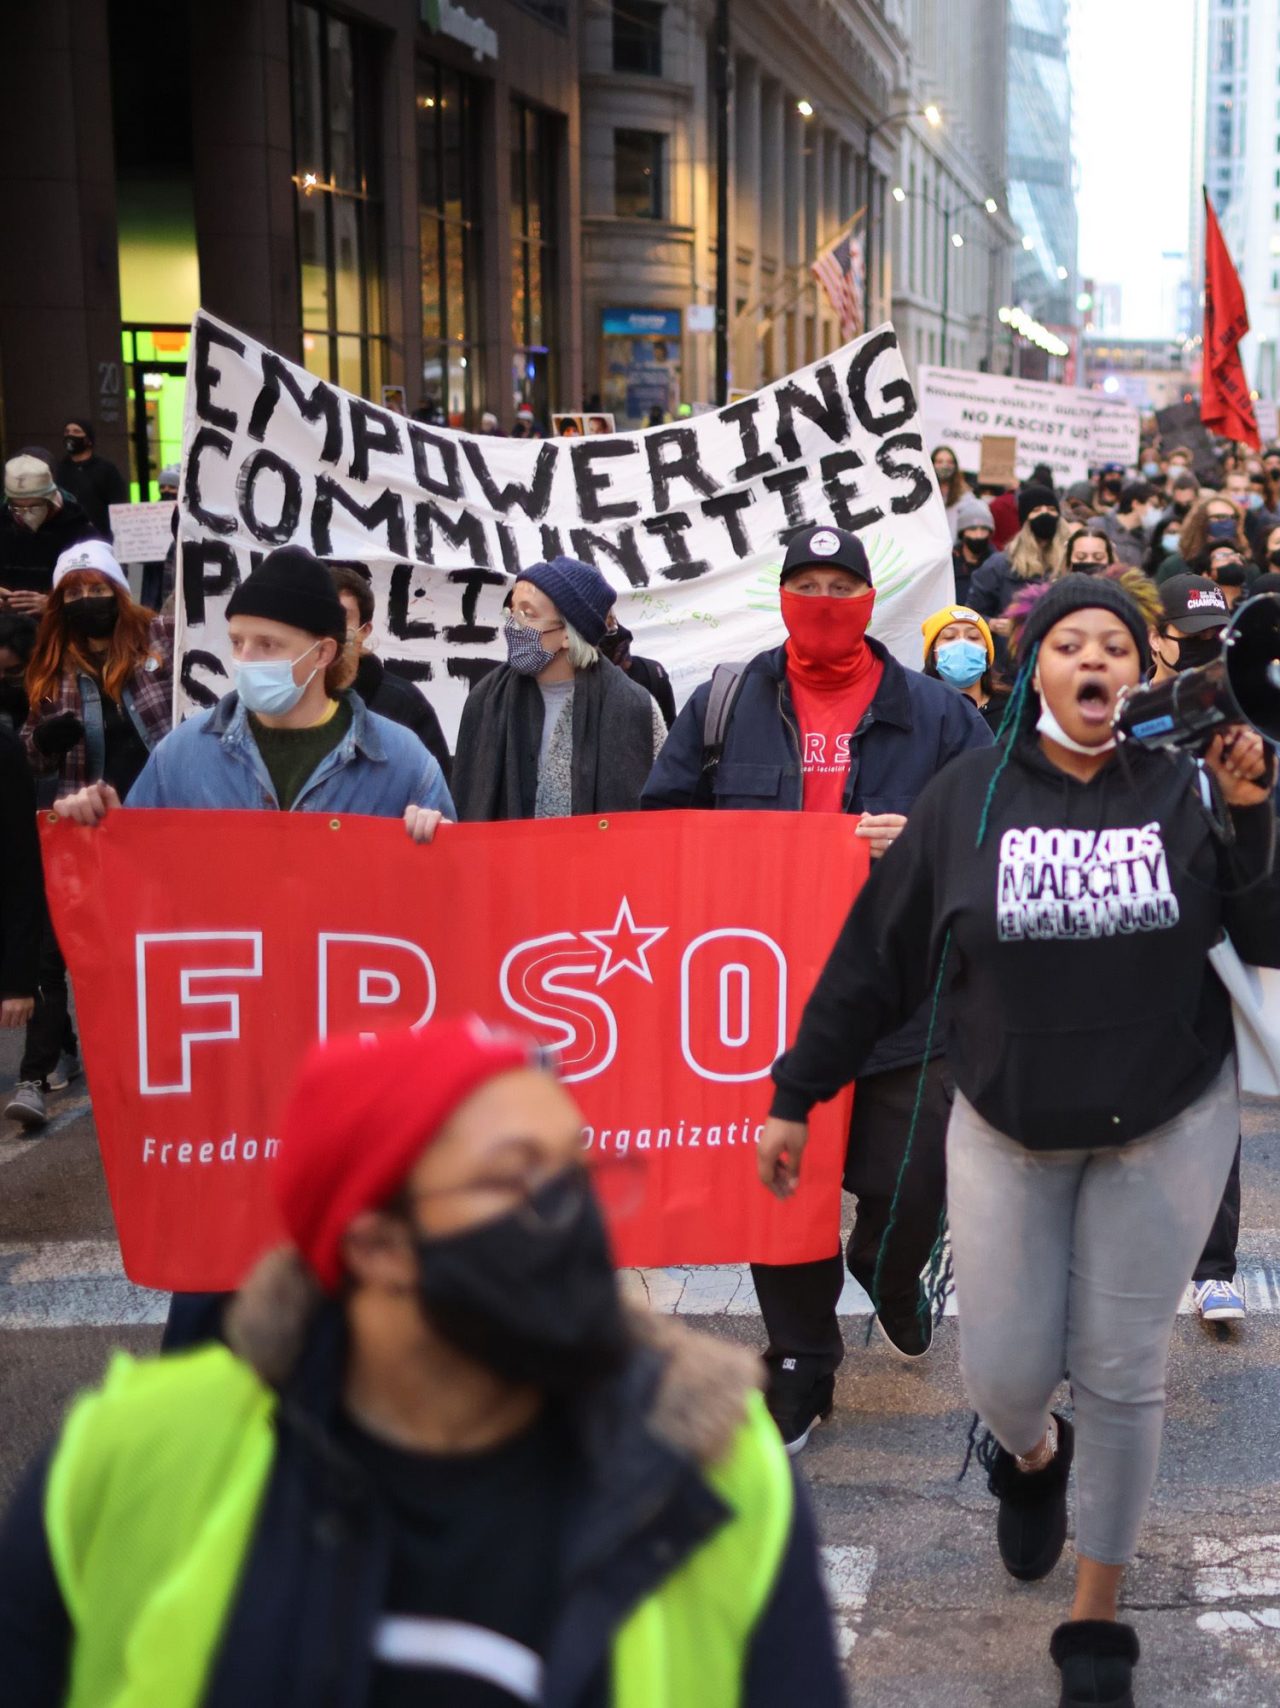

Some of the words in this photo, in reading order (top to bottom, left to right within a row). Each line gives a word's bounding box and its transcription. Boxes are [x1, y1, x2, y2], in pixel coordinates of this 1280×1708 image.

[194, 320, 918, 524] EMPOWERING
[942, 428, 982, 442] ORGA
[961, 408, 989, 424] NO
[994, 412, 1066, 435] FASCIST
[1070, 426, 1091, 440] US
[186, 427, 933, 588] COMMUNITIES
[182, 540, 508, 643] PLI
[803, 732, 853, 764] RS
[136, 928, 788, 1096] FRSO
[143, 1133, 284, 1164] Freedom
[580, 1118, 765, 1158] Organizatio
